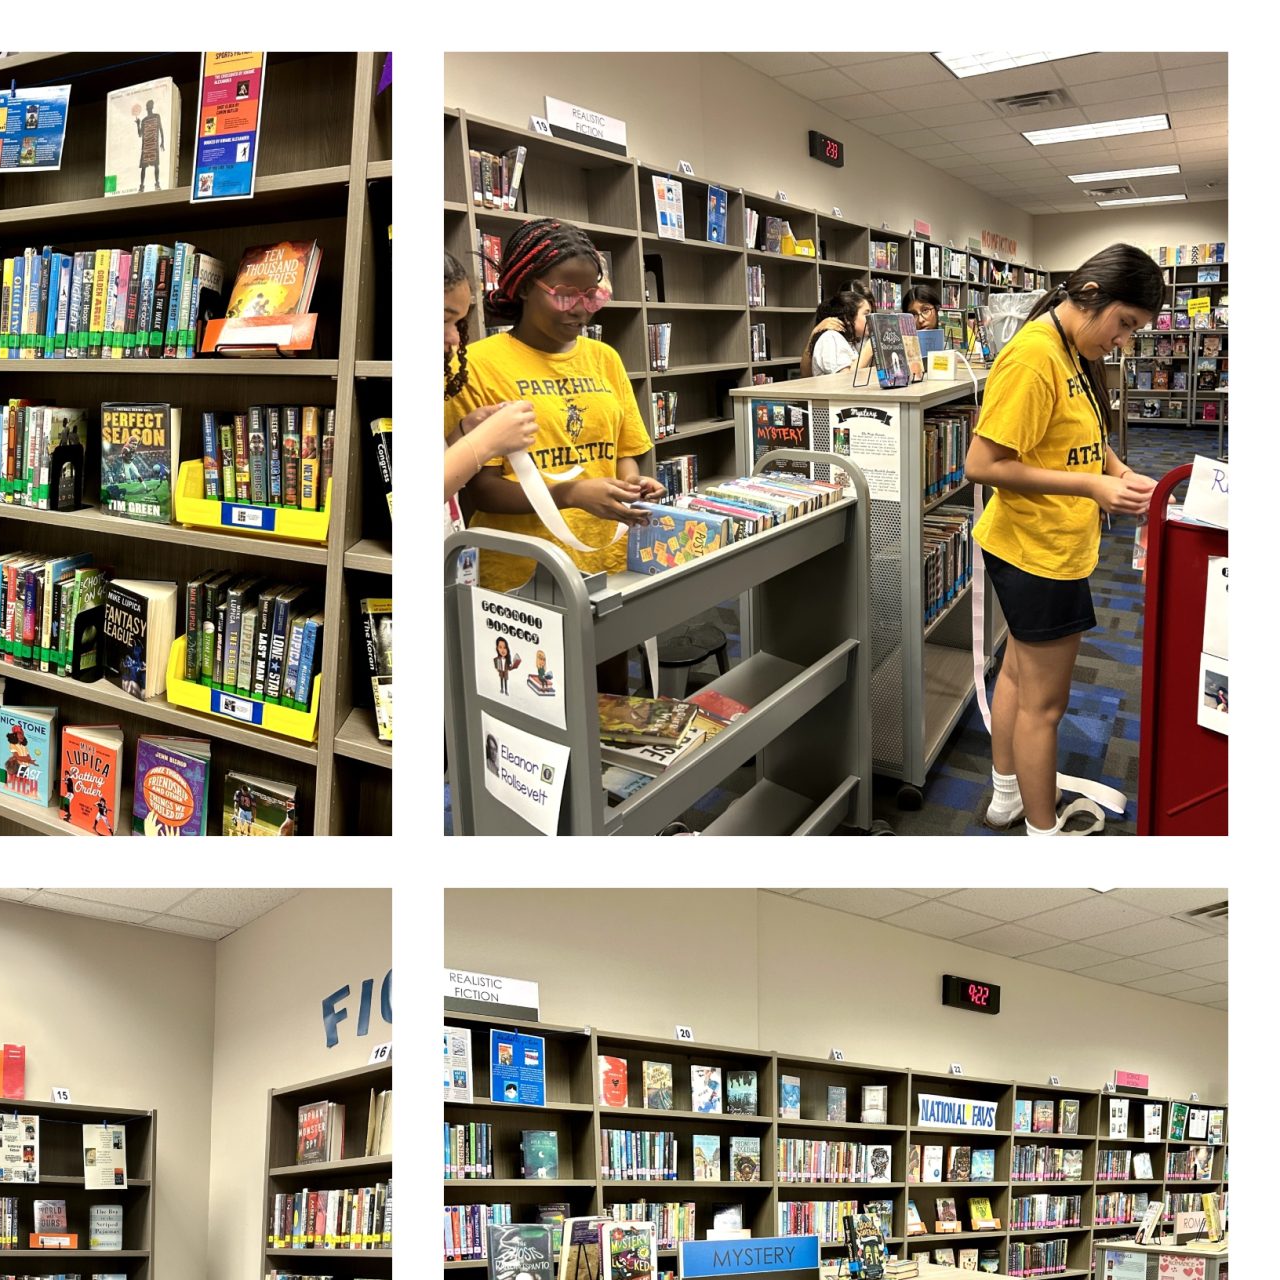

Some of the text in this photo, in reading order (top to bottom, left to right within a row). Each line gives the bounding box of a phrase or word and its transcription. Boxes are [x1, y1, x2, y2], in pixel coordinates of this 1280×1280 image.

[536, 120, 548, 133] 19
[572, 108, 606, 128] REALISTIC
[575, 122, 604, 138] FICTION
[174, 245, 185, 282] FEINSTEIN
[264, 248, 285, 263] TEN
[245, 258, 299, 277] THOUSAND
[95, 270, 105, 299] GOLDEN
[268, 271, 297, 285] TRIES
[516, 378, 612, 396] PARKHILL
[103, 412, 164, 429] PERFECT
[252, 407, 260, 429] GREEN
[287, 409, 295, 431] GREEN
[850, 408, 877, 419] Mystery
[102, 428, 166, 447] SEASON
[756, 427, 805, 445] MYSTERY
[527, 442, 614, 470] ATHLETIC
[303, 464, 313, 498] NEW KID
[107, 499, 161, 517] TIM GREEN
[107, 591, 141, 613] MIKE LUPICA
[104, 603, 147, 639] FANTASY
[189, 604, 197, 632] LUPICA
[103, 623, 134, 647] LEAGUE
[289, 626, 304, 666] LUPICA
[257, 632, 268, 680] LAST MAN
[269, 634, 285, 698] LONE STAR
[0, 715, 47, 736] NIC STONE
[79, 741, 96, 752] MIKE
[66, 750, 111, 778] LUPICA
[154, 751, 168, 762] JENN
[500, 744, 539, 775] Eleanor
[17, 765, 43, 780] FAST
[69, 766, 105, 788] Batting
[6, 775, 39, 796] PITCH
[74, 780, 103, 798] Order
[148, 777, 189, 801] FRIENDSHIP
[149, 792, 174, 810] THINGS
[150, 802, 185, 819] FOULED UP
[449, 972, 503, 990] REALISTIC
[454, 987, 500, 1003] FICTION
[967, 983, 990, 1006] 9:22
[679, 1028, 691, 1040] 20
[373, 1045, 387, 1060] 16
[953, 1064, 963, 1075] 22
[56, 1089, 69, 1101] 15
[299, 1109, 324, 1124] ORPHAN
[921, 1098, 996, 1129] NATIONAL FAVS
[298, 1124, 326, 1137] MONSTER
[305, 1139, 318, 1150] SPY
[39, 1206, 62, 1215] WORLD
[611, 1233, 649, 1254] MYSTERY
[611, 1256, 650, 1272] LOCKED
[712, 1245, 796, 1268] MYSTERY
